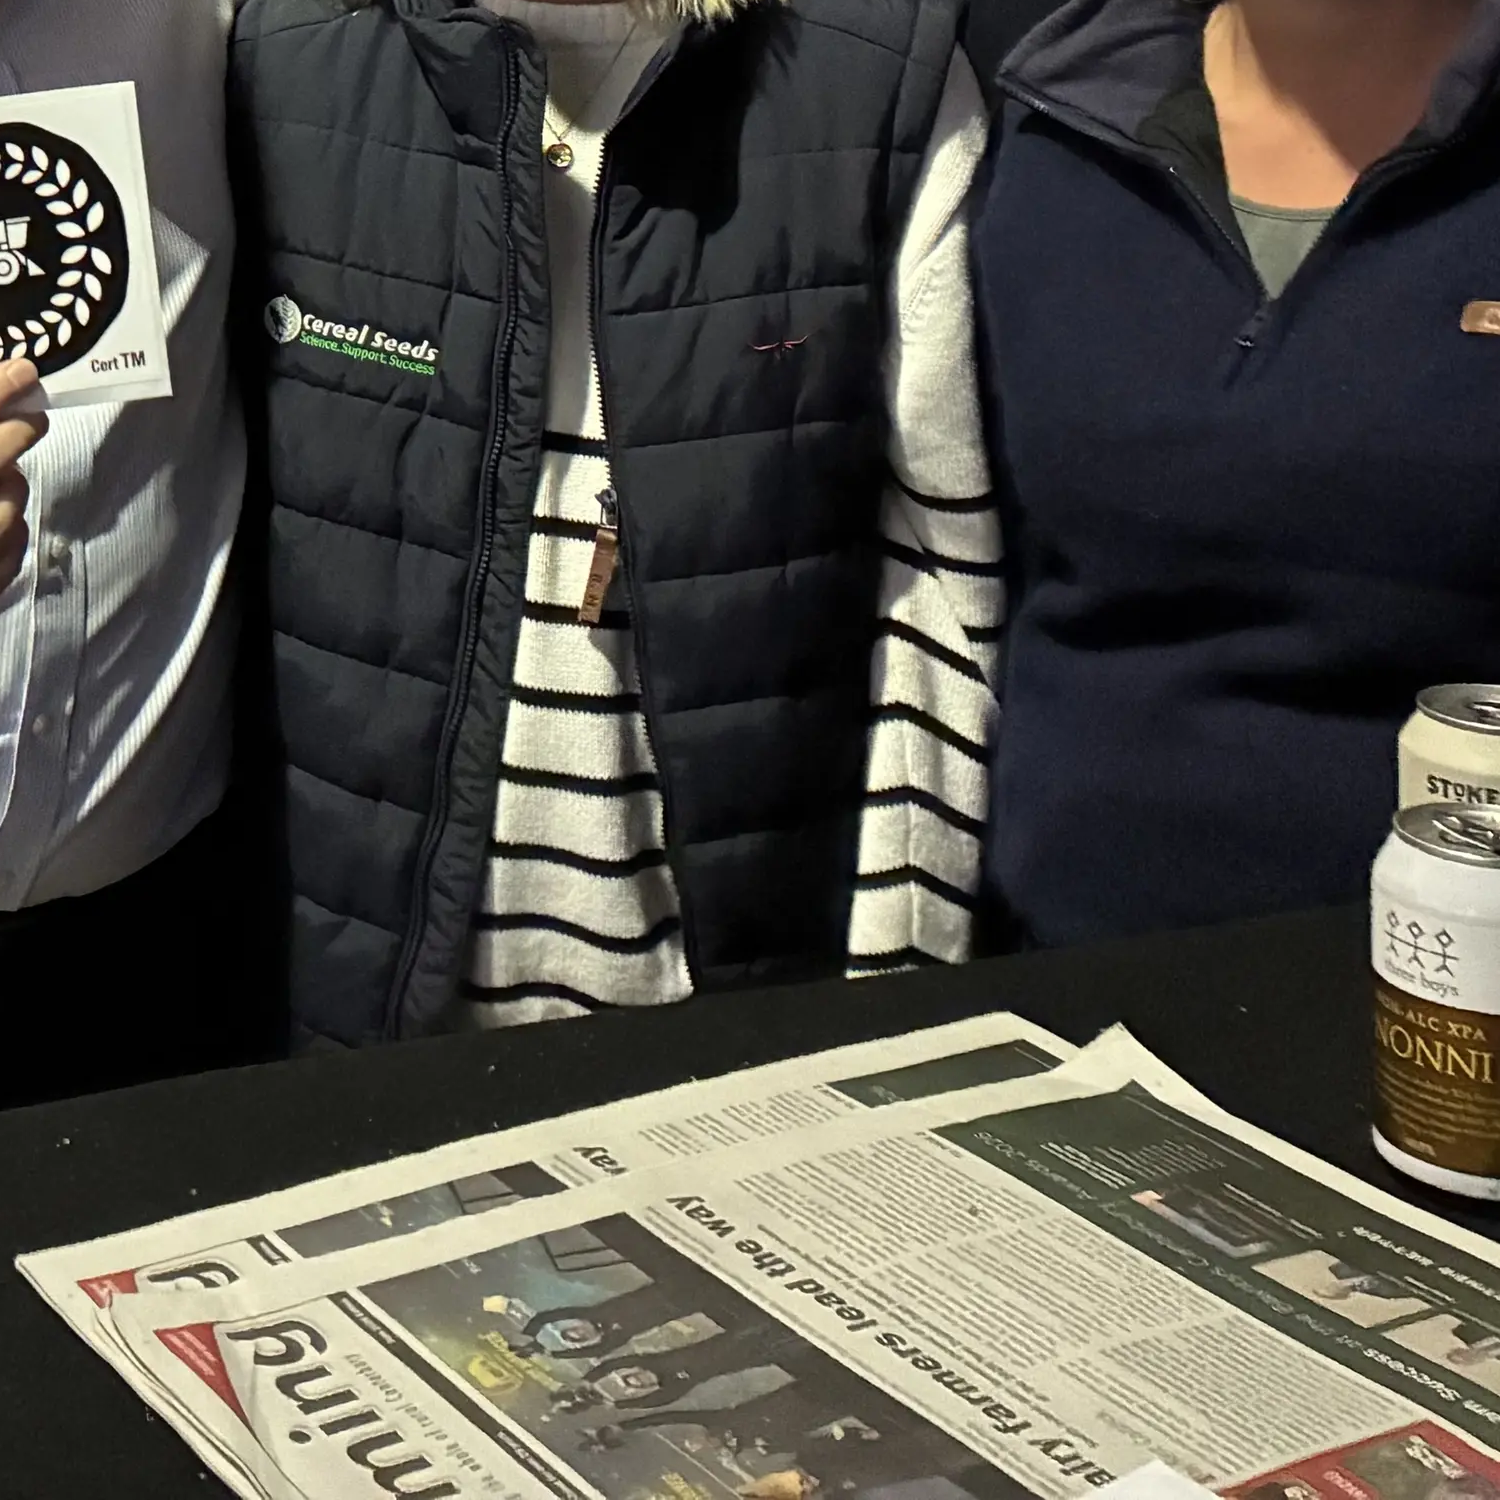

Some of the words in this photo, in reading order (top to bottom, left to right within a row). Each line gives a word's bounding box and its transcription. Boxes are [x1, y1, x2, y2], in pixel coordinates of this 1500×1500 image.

[119, 350, 146, 368] TM
[371, 331, 439, 361] Seeds
[389, 354, 436, 376] Success
[1420, 972, 1460, 997] boys
[1376, 1015, 1494, 1084] NONNI
[1447, 1020, 1487, 1041] XPA
[666, 1195, 736, 1238] way
[735, 1239, 797, 1278] the
[784, 1278, 879, 1332] lead
[875, 1332, 1032, 1436] farmers
[1028, 1438, 1117, 1488] airy
